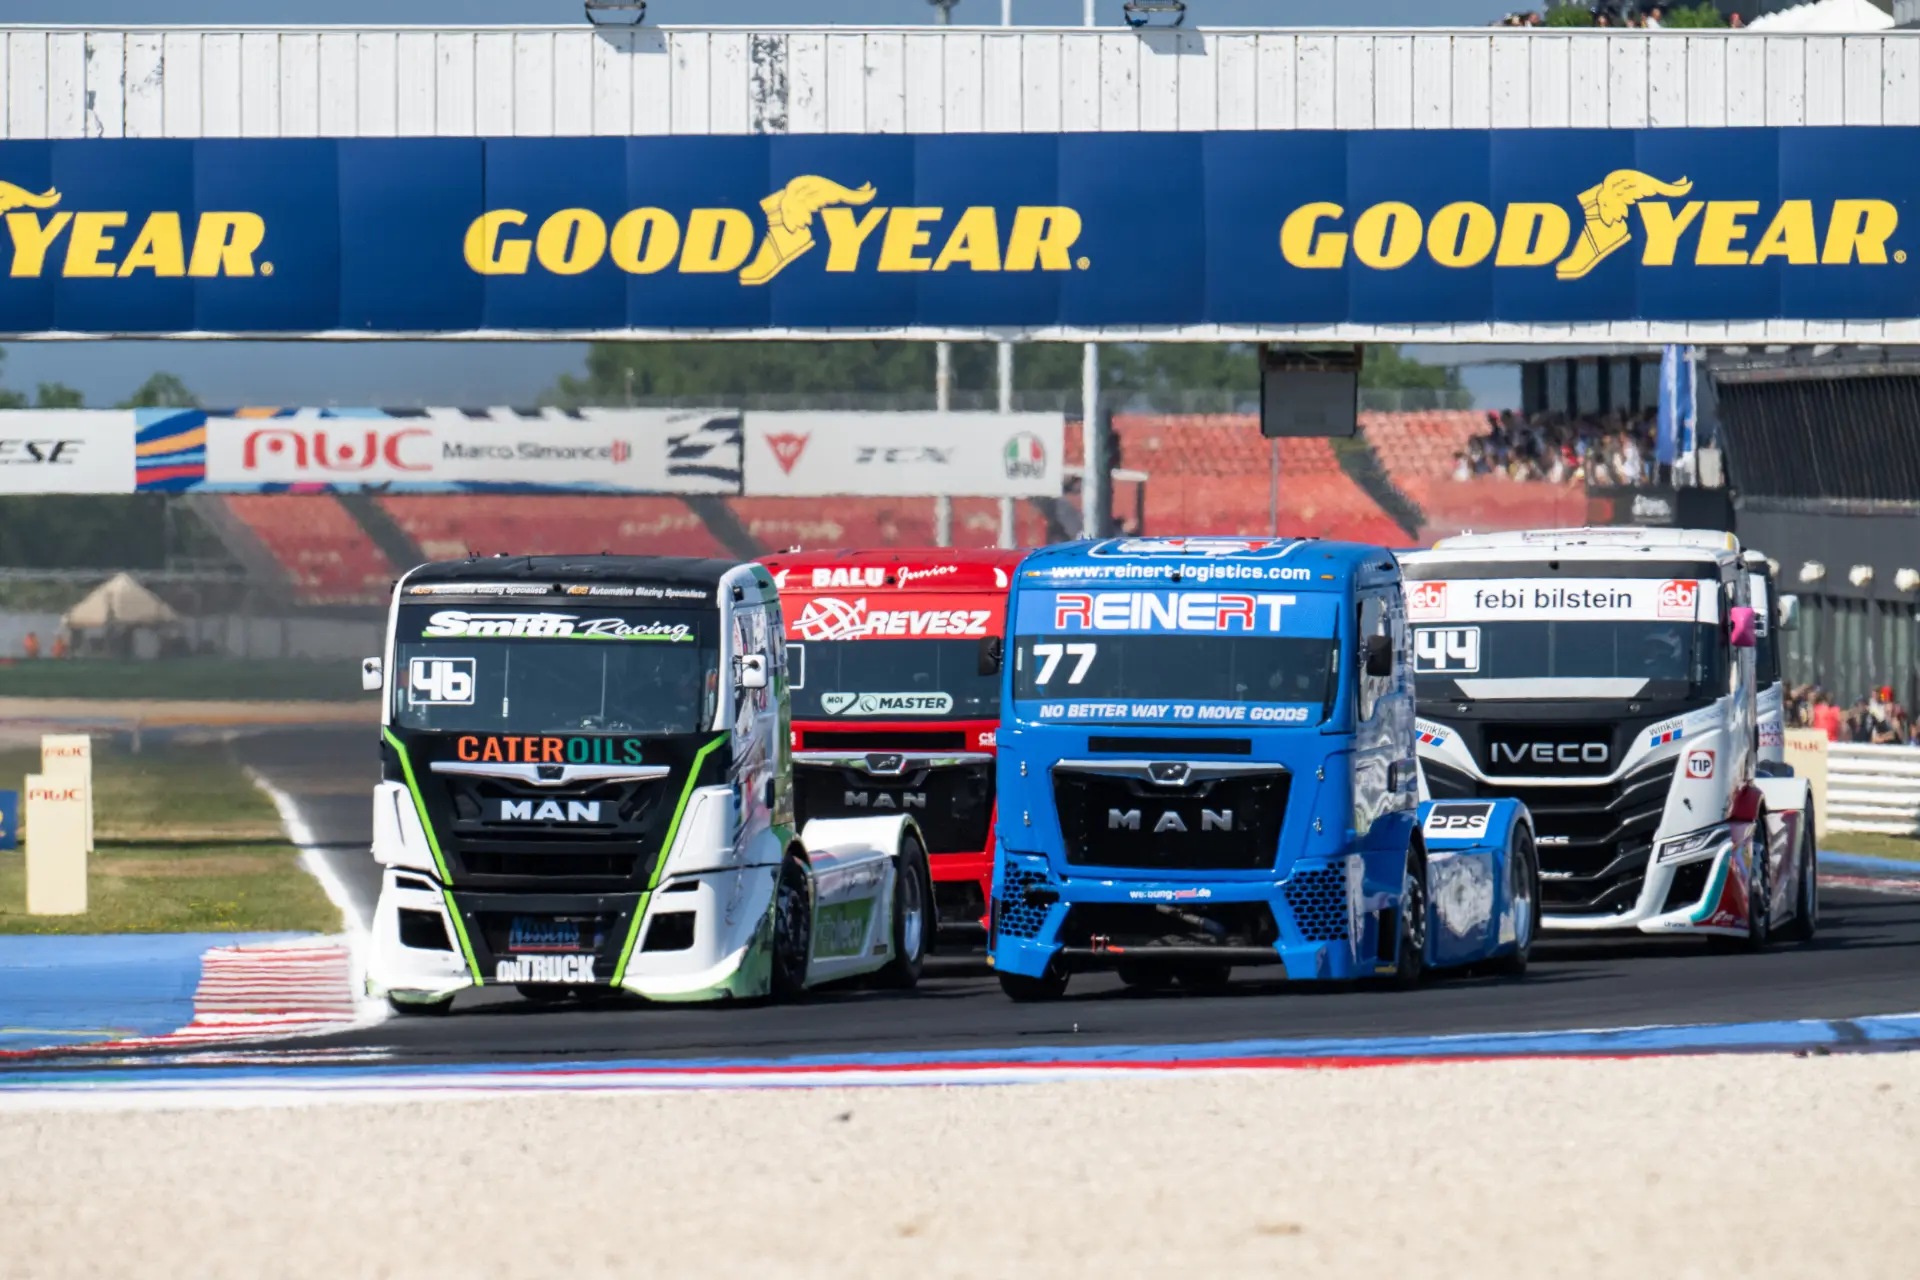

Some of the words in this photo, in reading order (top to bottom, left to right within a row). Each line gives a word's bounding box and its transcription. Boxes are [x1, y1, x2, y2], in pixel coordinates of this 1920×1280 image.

[441, 441, 514, 460] Marco
[811, 567, 886, 588] BALU
[897, 564, 958, 589] Junior
[1051, 562, 1312, 583] www.reinert-logistics.com
[589, 586, 634, 597] Automotive
[635, 587, 664, 598] Glazing
[665, 588, 707, 598] Specialists
[1475, 589, 1524, 609] febi
[1534, 588, 1632, 609] bilstein
[1054, 592, 1297, 632] REINERT
[425, 610, 578, 638] Smith
[579, 617, 691, 641] Racing
[863, 610, 992, 636] REVESZ
[1418, 630, 1478, 669] 44
[1032, 642, 1097, 685] 77
[878, 696, 948, 710] MASTER
[1039, 703, 1064, 718] NO
[1068, 703, 1128, 718] BETTER
[1131, 704, 1171, 719] WAY
[1173, 705, 1195, 719] TO
[1198, 705, 1246, 721] MOVE
[1249, 706, 1309, 722] GOODS
[1649, 718, 1685, 737] winkler
[1490, 742, 1609, 764] IVECO
[1690, 758, 1712, 773] TIP
[843, 791, 927, 809] MAN
[501, 800, 600, 822] MAN
[1107, 808, 1233, 833] MAN
